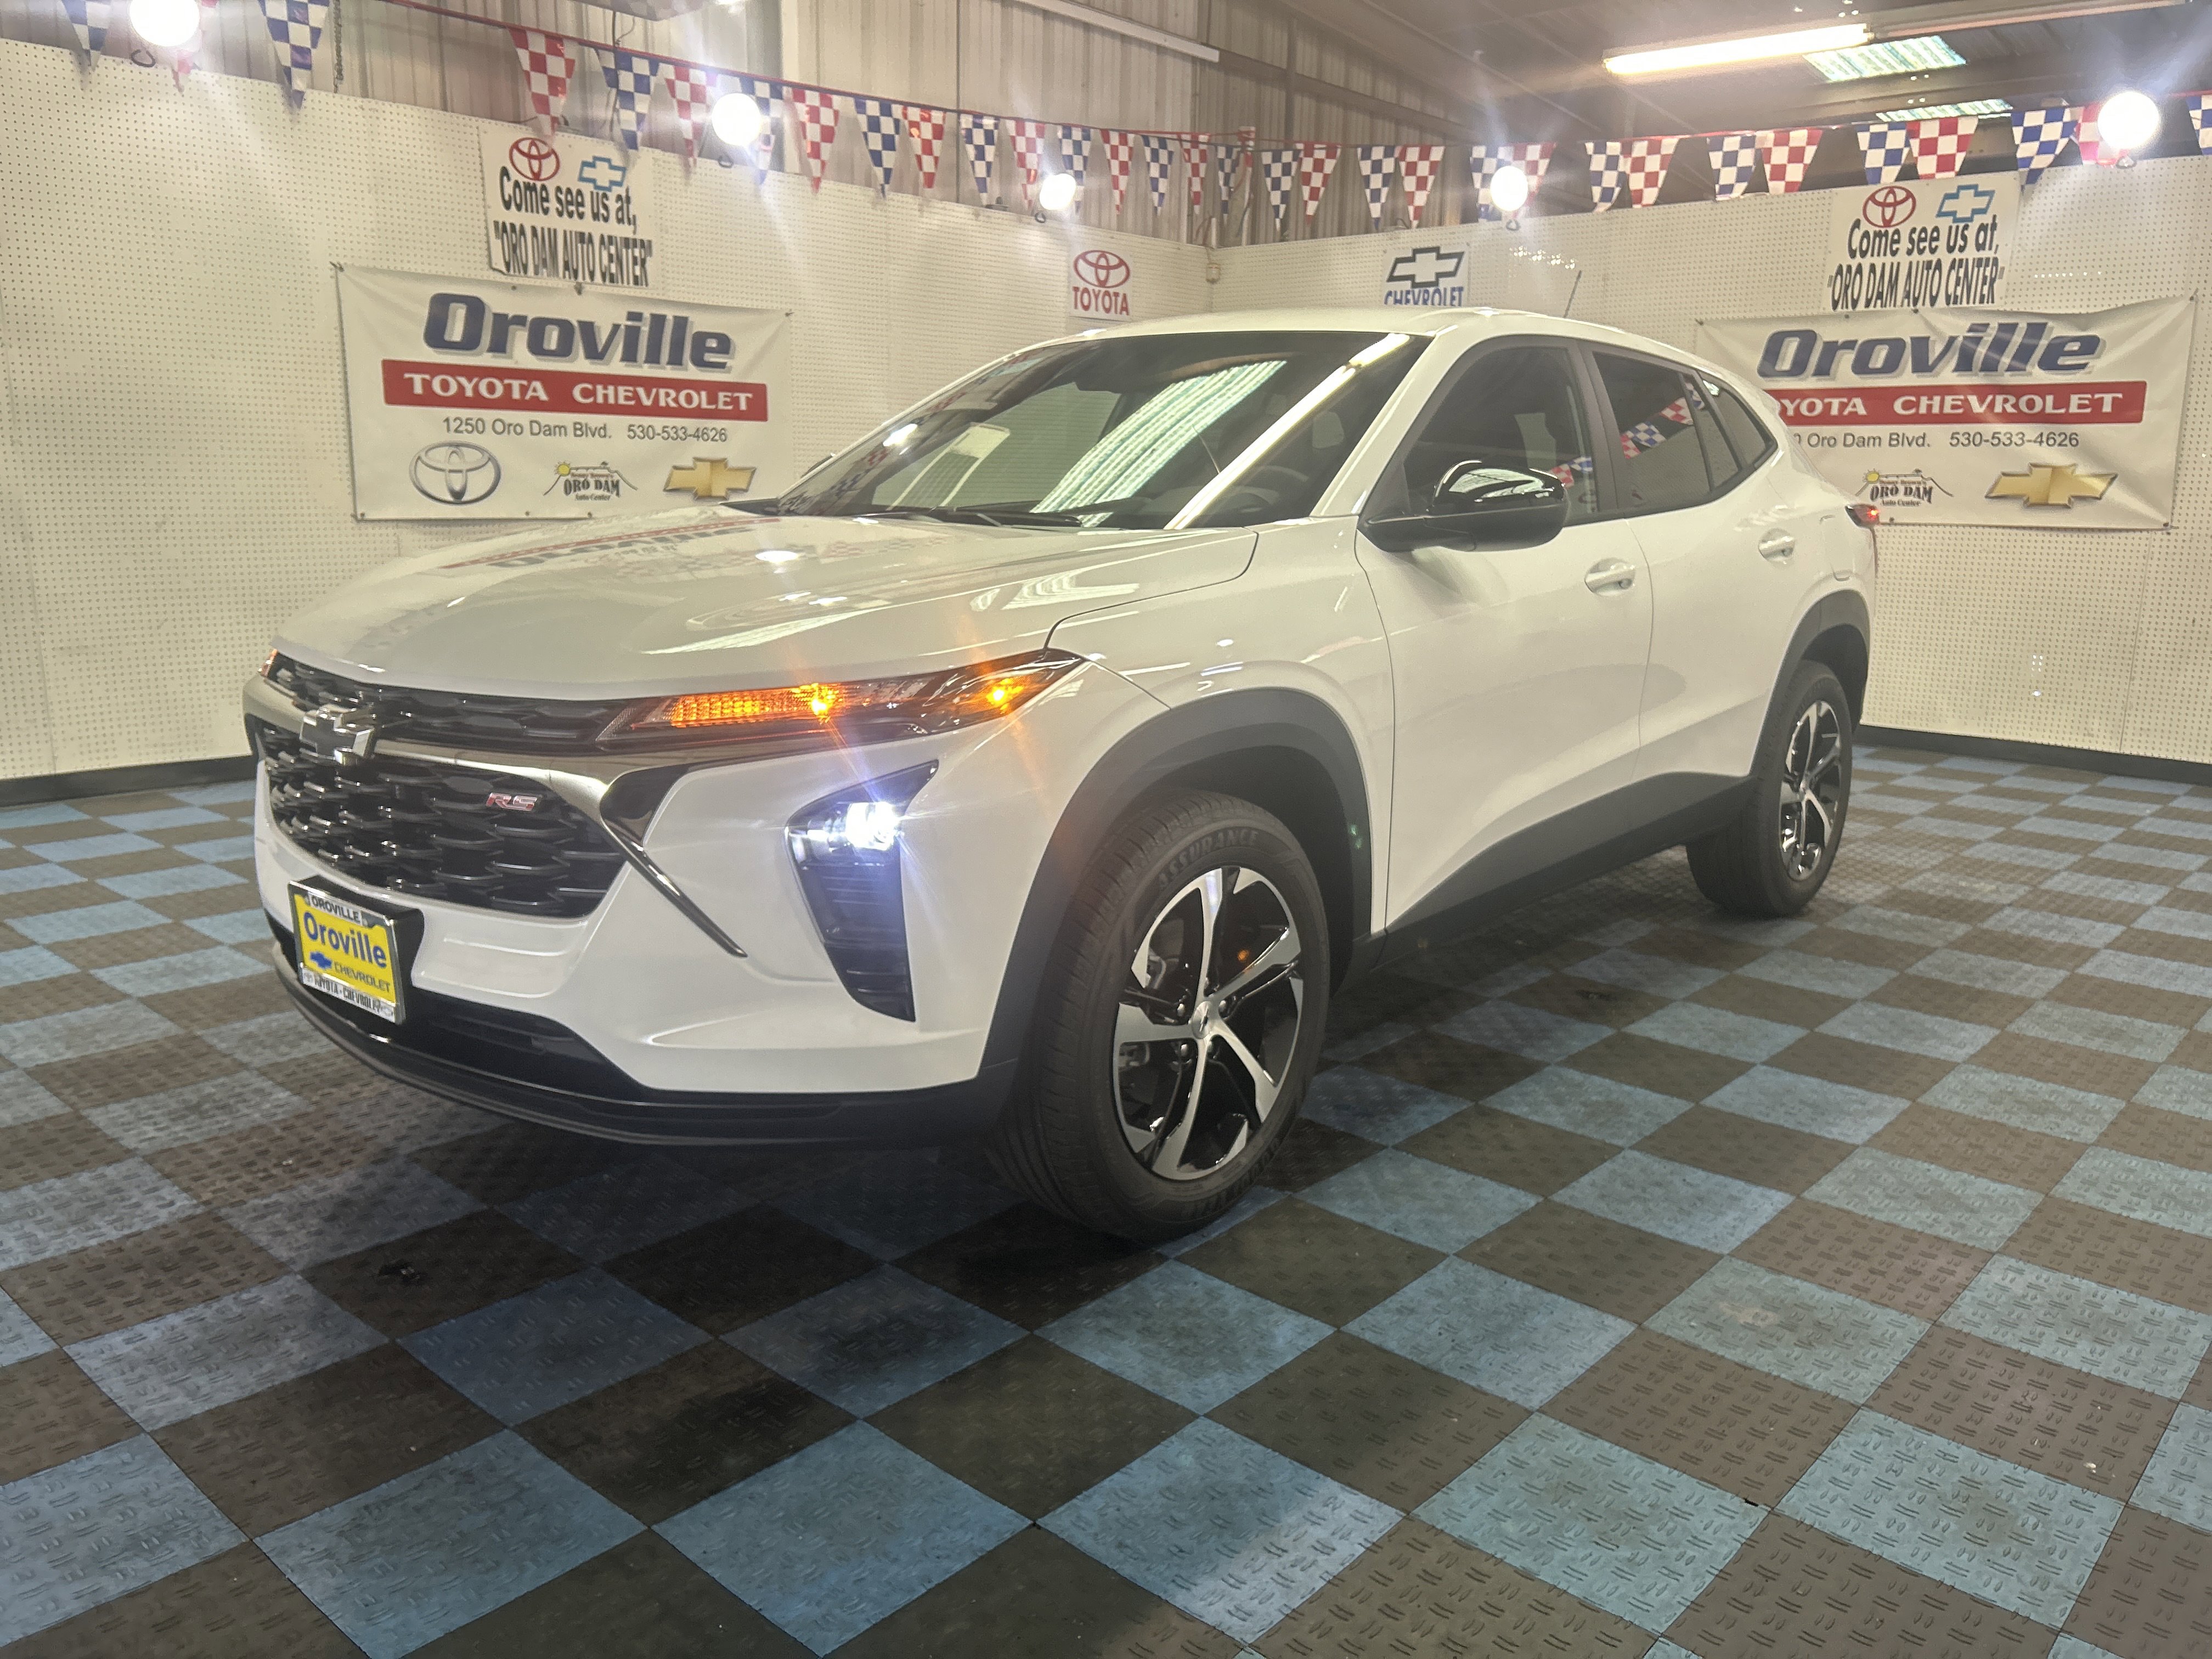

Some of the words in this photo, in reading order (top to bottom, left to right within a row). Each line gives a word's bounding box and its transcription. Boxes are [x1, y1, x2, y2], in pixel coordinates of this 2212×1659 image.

[500, 166, 550, 215] Come
[555, 185, 584, 219] see
[590, 190, 609, 222] us
[531, 225, 560, 277] DAM
[562, 229, 595, 282] AUTO
[1848, 218, 1900, 259] Come
[1906, 225, 1940, 256] see
[1946, 222, 1970, 253] us
[1865, 261, 1900, 309] DAM
[1901, 258, 1942, 308] AUTO
[1072, 286, 1130, 316] TOYOTA
[423, 292, 732, 370] Oroville
[1757, 322, 2101, 379] Oroville
[403, 372, 549, 401] TOYOTA
[572, 382, 753, 411] CHEVROLET
[1780, 397, 1867, 416] YOTA
[1893, 392, 2123, 415] CHEVROLET
[443, 416, 486, 435] 1250
[492, 418, 523, 436] Oro
[529, 419, 567, 437] Dam
[573, 421, 612, 438] Blvd.
[627, 424, 727, 443] 530-533-4626
[1807, 432, 1837, 448] Oro
[1843, 432, 1881, 448] Dam
[1888, 432, 1931, 448] Blvd.
[1949, 431, 2079, 448] 530-533-4626
[563, 478, 590, 496] ORO
[595, 479, 620, 498] DAM
[1870, 484, 1899, 501] ORO
[1904, 486, 1933, 504] DAM
[486, 792, 538, 811] RS
[312, 896, 360, 923] OROVILLE
[304, 912, 387, 968] Oroville
[334, 961, 391, 992] CHEVROLET
